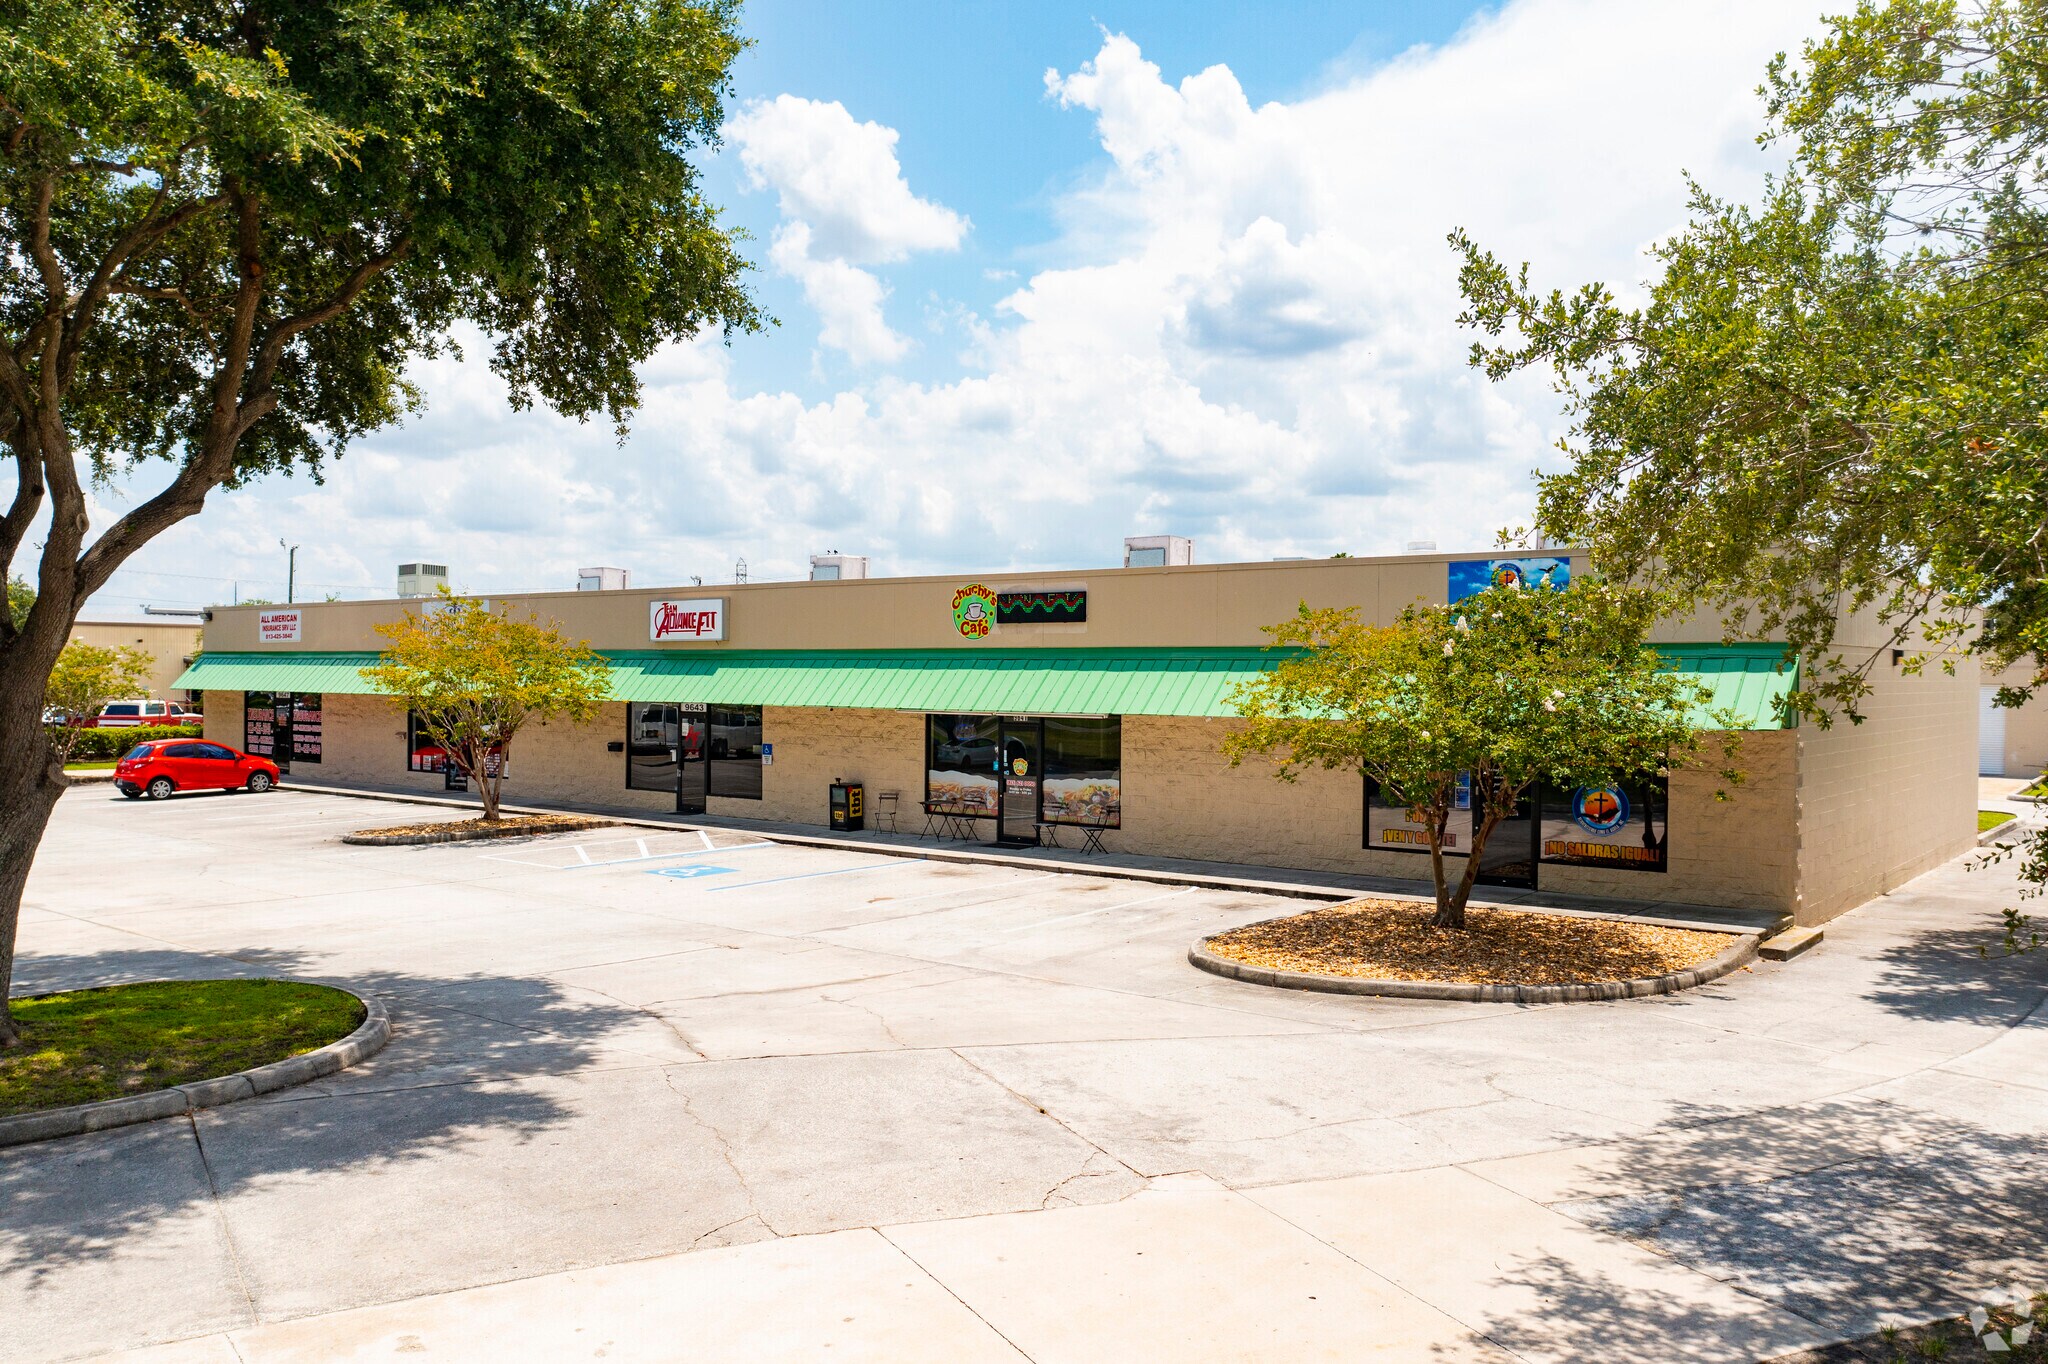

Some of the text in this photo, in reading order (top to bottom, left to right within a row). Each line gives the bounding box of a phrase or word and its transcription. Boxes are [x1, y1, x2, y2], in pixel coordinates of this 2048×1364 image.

[951, 584, 996, 610] Chuchy's
[261, 614, 297, 623] ALL AMERICAN
[684, 703, 704, 711] 9643
[851, 790, 861, 815] tbt
[835, 811, 844, 819] tbt
[1383, 829, 1405, 843] ¡VEN
[1407, 830, 1415, 843] Y
[1545, 840, 1660, 862] ¡NO SALDRAS IGUAL!
